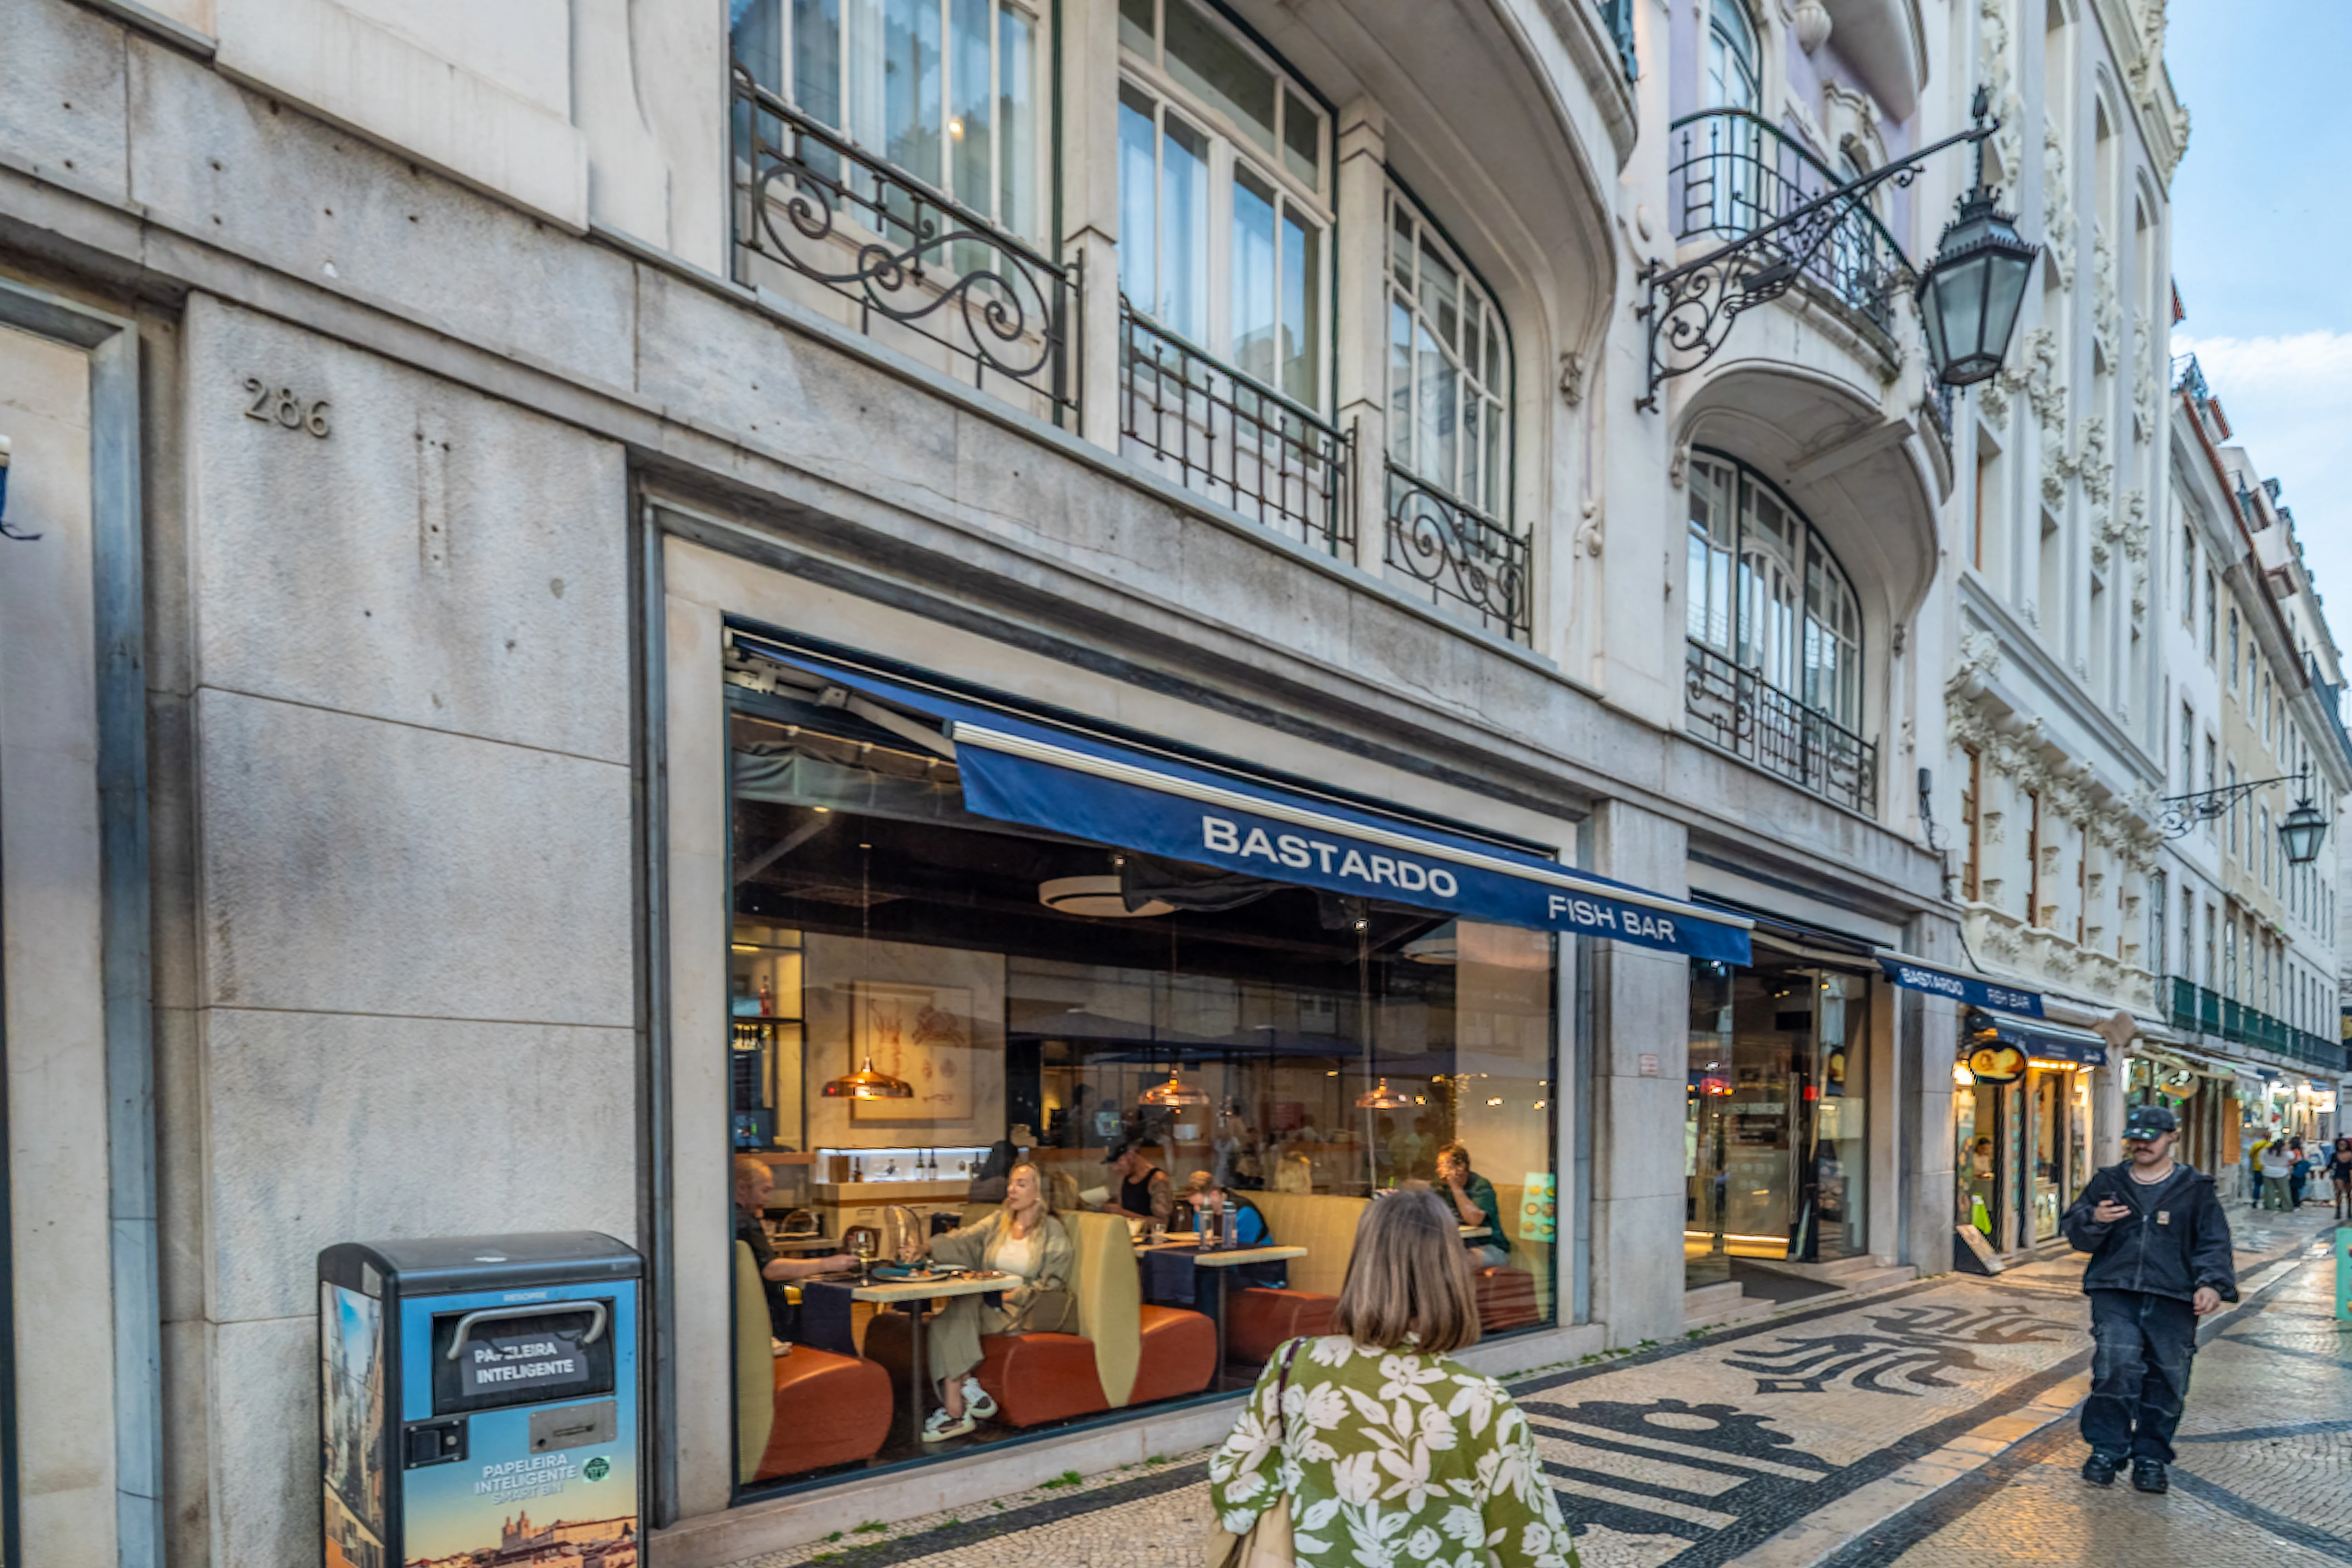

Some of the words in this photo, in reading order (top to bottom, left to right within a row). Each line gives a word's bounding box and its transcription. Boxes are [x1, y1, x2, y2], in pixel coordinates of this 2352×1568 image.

[242, 378, 332, 439] 286
[1202, 815, 1458, 898] BASTARDO
[1548, 894, 1617, 929] FISH
[1620, 910, 1676, 943] BAR
[476, 1359, 575, 1384] INTELIGENTE
[482, 1453, 568, 1478] PAPELEIRA
[474, 1465, 578, 1496] INTELIGENTE
[492, 1488, 538, 1505] SMART
[541, 1481, 564, 1496] BIN
